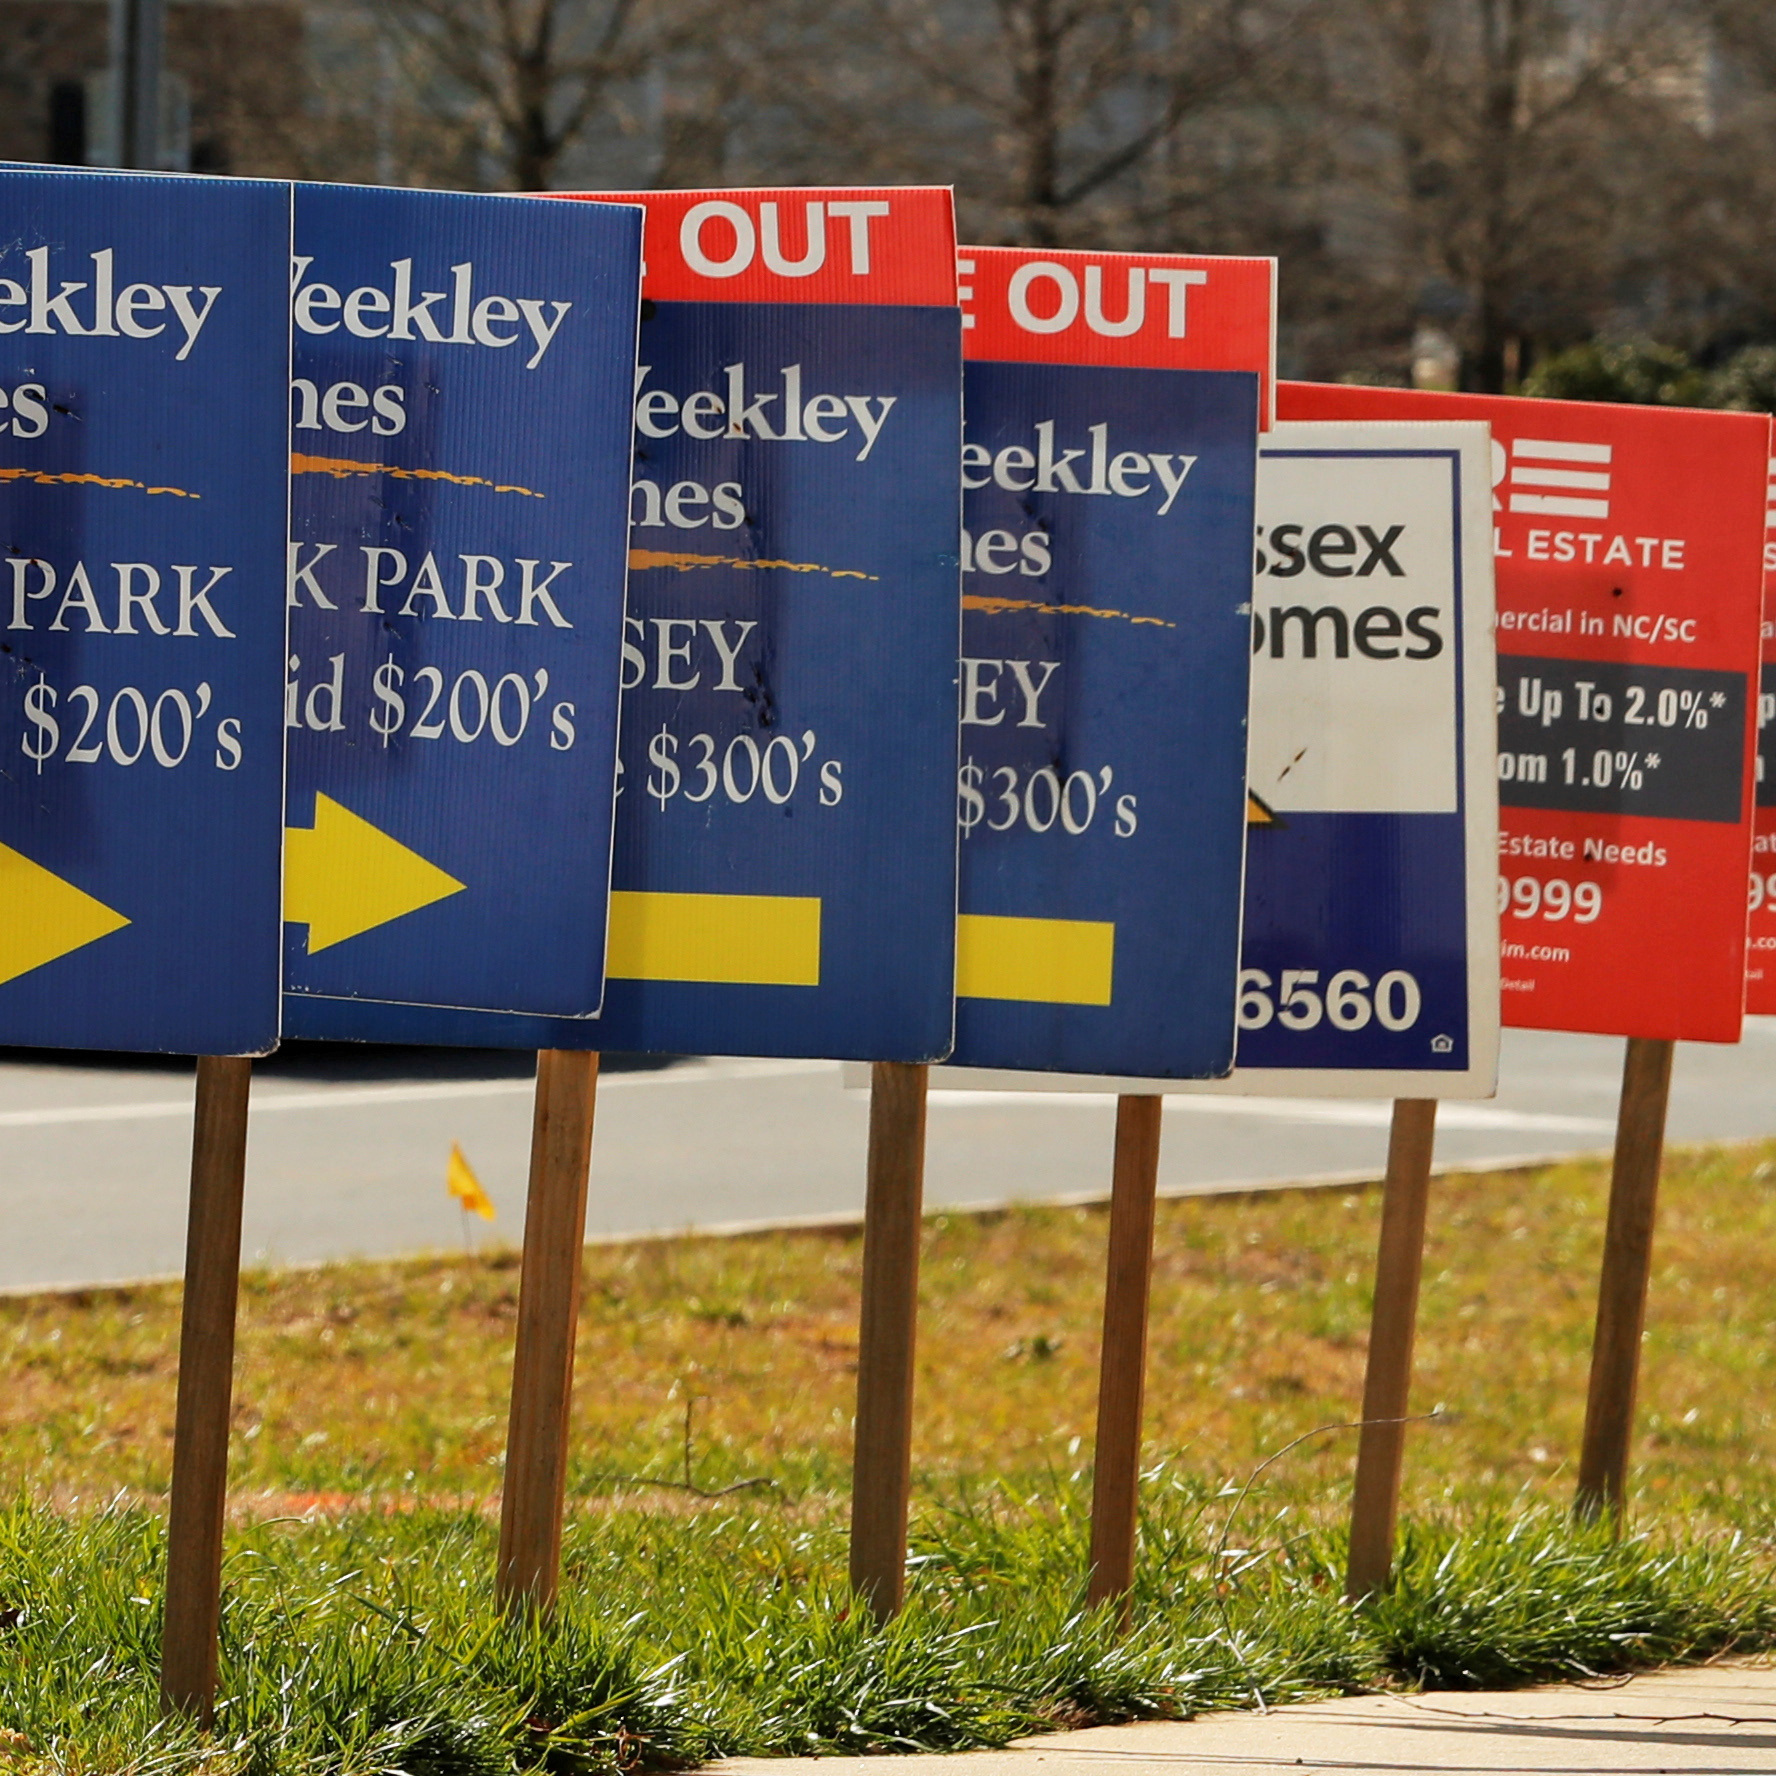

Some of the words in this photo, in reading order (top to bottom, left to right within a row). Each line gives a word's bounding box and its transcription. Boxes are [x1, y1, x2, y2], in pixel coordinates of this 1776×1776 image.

[680, 200, 889, 278] OUT
[292, 255, 572, 370] eekley
[1008, 261, 1207, 339] OUT
[634, 363, 897, 462] eekley
[359, 546, 574, 629] PARK
[961, 526, 1052, 576] es
[1255, 523, 1407, 578] sex
[1526, 529, 1686, 571] ESTATE
[4, 556, 237, 639] PARK
[1252, 605, 1444, 661] mes
[1494, 606, 1571, 634] ercial
[1580, 610, 1604, 637] in
[1613, 613, 1697, 644] NC/SC
[621, 616, 758, 692] SEY
[21, 672, 243, 776] $200's
[368, 653, 576, 751] $200's
[1518, 676, 1563, 728] Up
[1574, 680, 1613, 723] To
[646, 723, 843, 812] $300's
[956, 755, 1138, 839] $300's
[1498, 831, 1575, 860] Estate
[1583, 836, 1668, 867] Needs
[1237, 967, 1422, 1033] 6560
